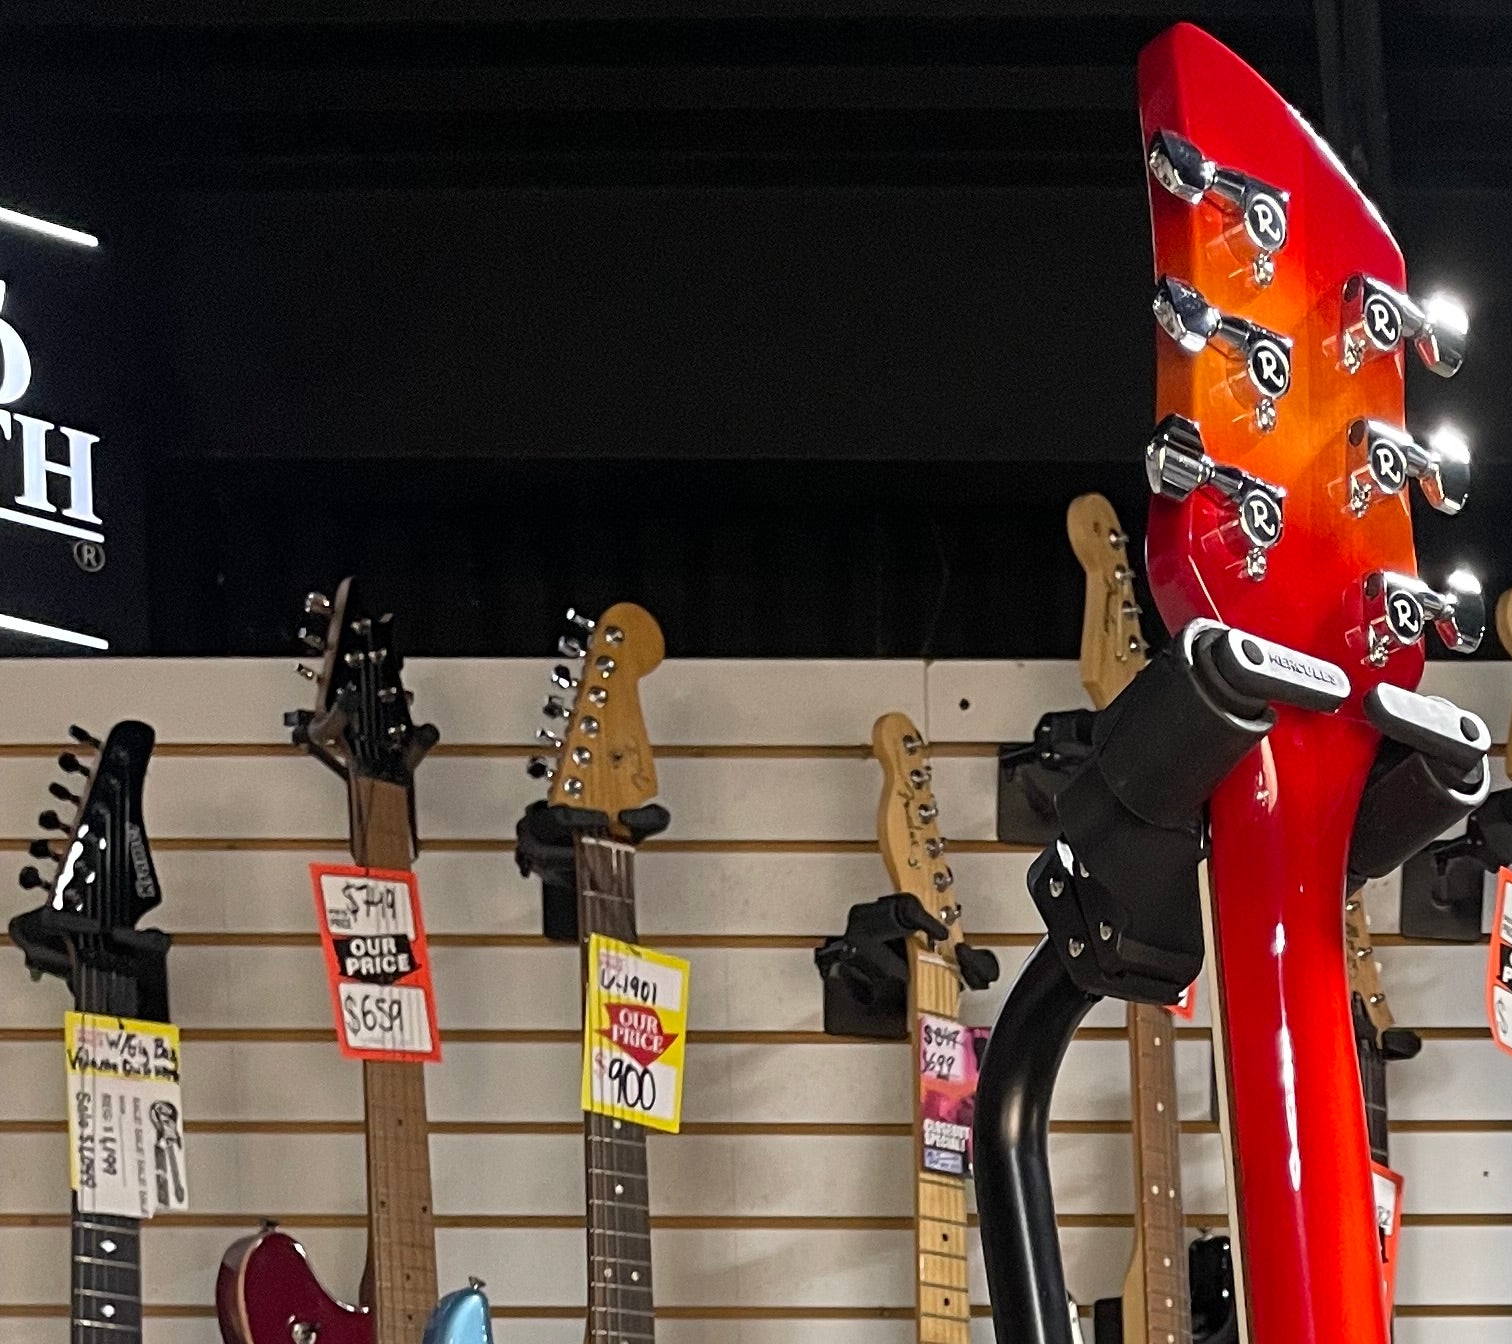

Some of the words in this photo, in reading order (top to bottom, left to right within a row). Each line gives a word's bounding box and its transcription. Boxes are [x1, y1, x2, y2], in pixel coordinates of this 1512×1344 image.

[1254, 203, 1281, 241] R
[1370, 303, 1396, 341] R
[1258, 349, 1285, 387] R
[1376, 448, 1402, 485] R
[1252, 499, 1277, 537] R
[1393, 599, 1420, 636] R
[344, 953, 411, 977] PRICE
[349, 936, 397, 957] OUR
[611, 1023, 666, 1054] PRICE
[618, 1007, 660, 1034] OUR
